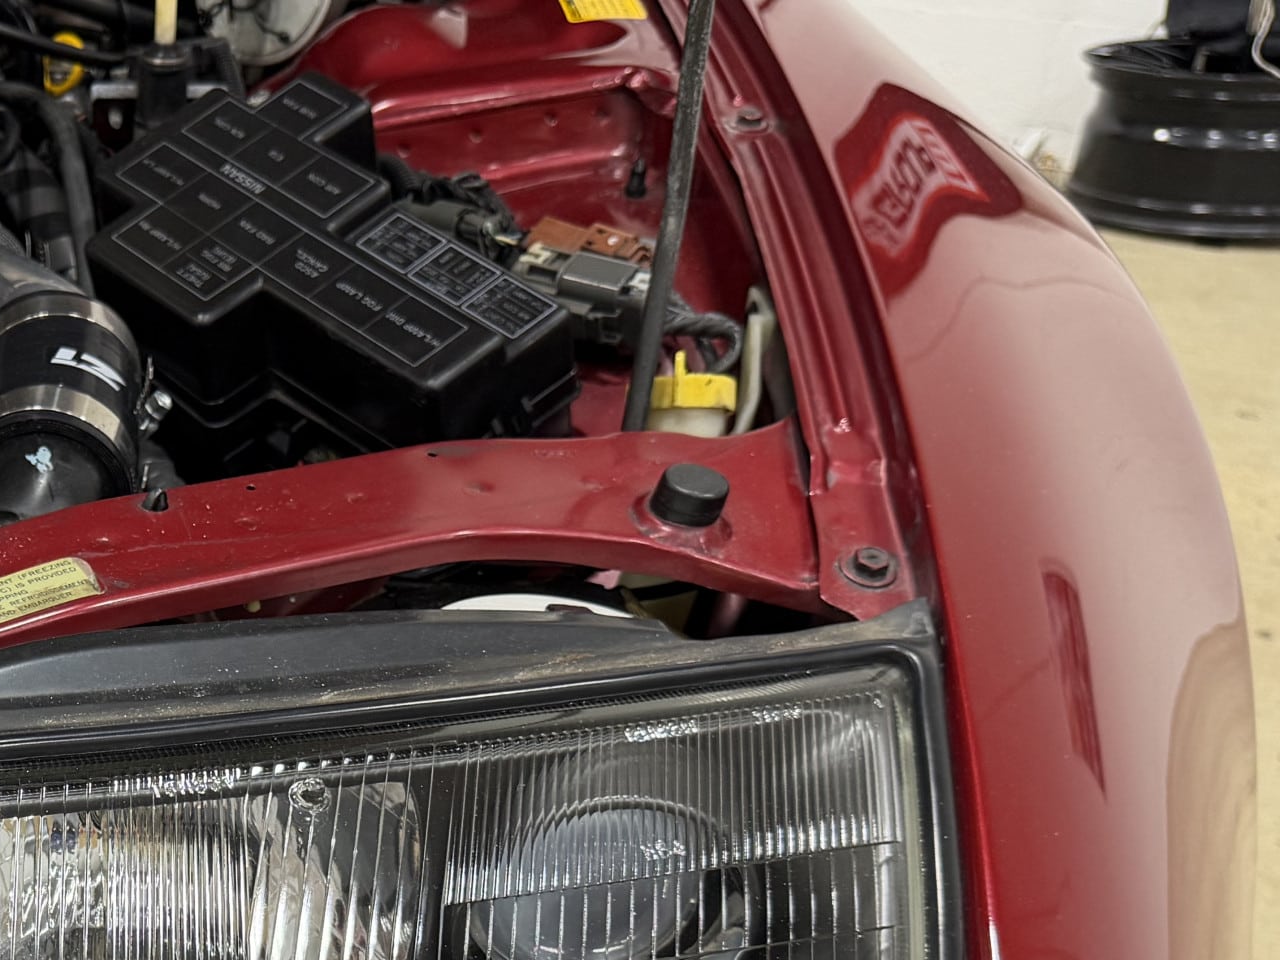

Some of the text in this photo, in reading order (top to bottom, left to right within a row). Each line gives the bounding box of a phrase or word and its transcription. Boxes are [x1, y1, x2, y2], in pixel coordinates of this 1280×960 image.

[220, 163, 266, 194] NISSAN
[336, 282, 383, 311] FOG LAMP
[15, 582, 25, 590] IS
[27, 567, 77, 585] PROVIDED
[17, 560, 71, 580] (FREEZING
[17, 592, 72, 612] EMBARQUER
